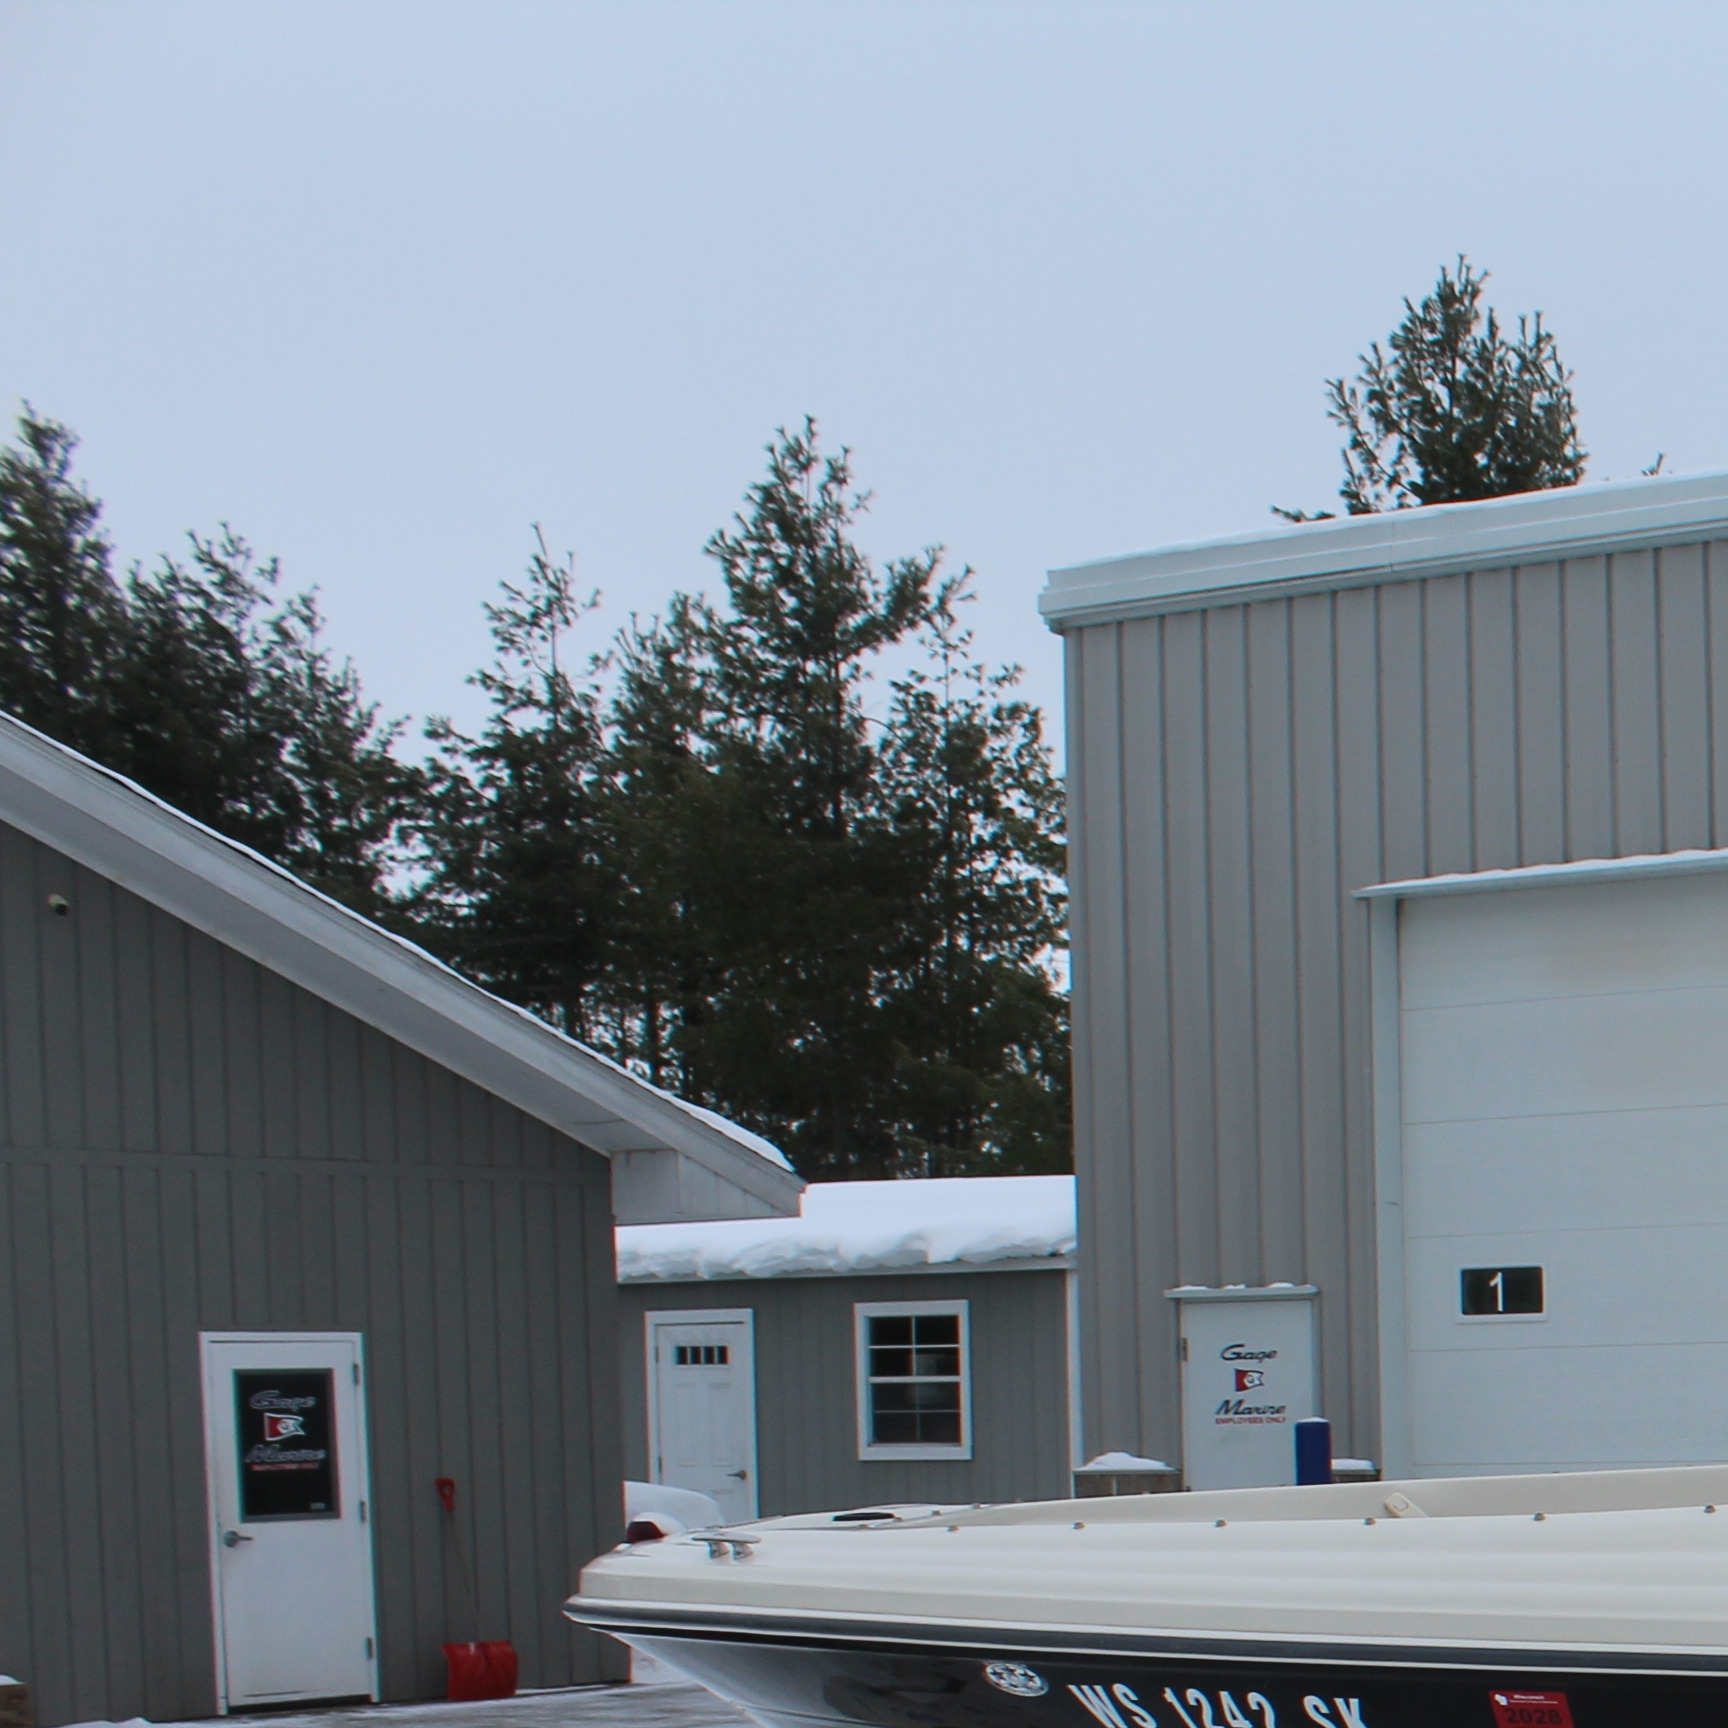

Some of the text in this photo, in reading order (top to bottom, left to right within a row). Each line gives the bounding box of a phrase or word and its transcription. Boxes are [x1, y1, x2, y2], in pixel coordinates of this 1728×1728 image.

[1489, 1271, 1504, 1312] 1
[1221, 1344, 1278, 1363] Gage
[1215, 1399, 1287, 1415] Marine
